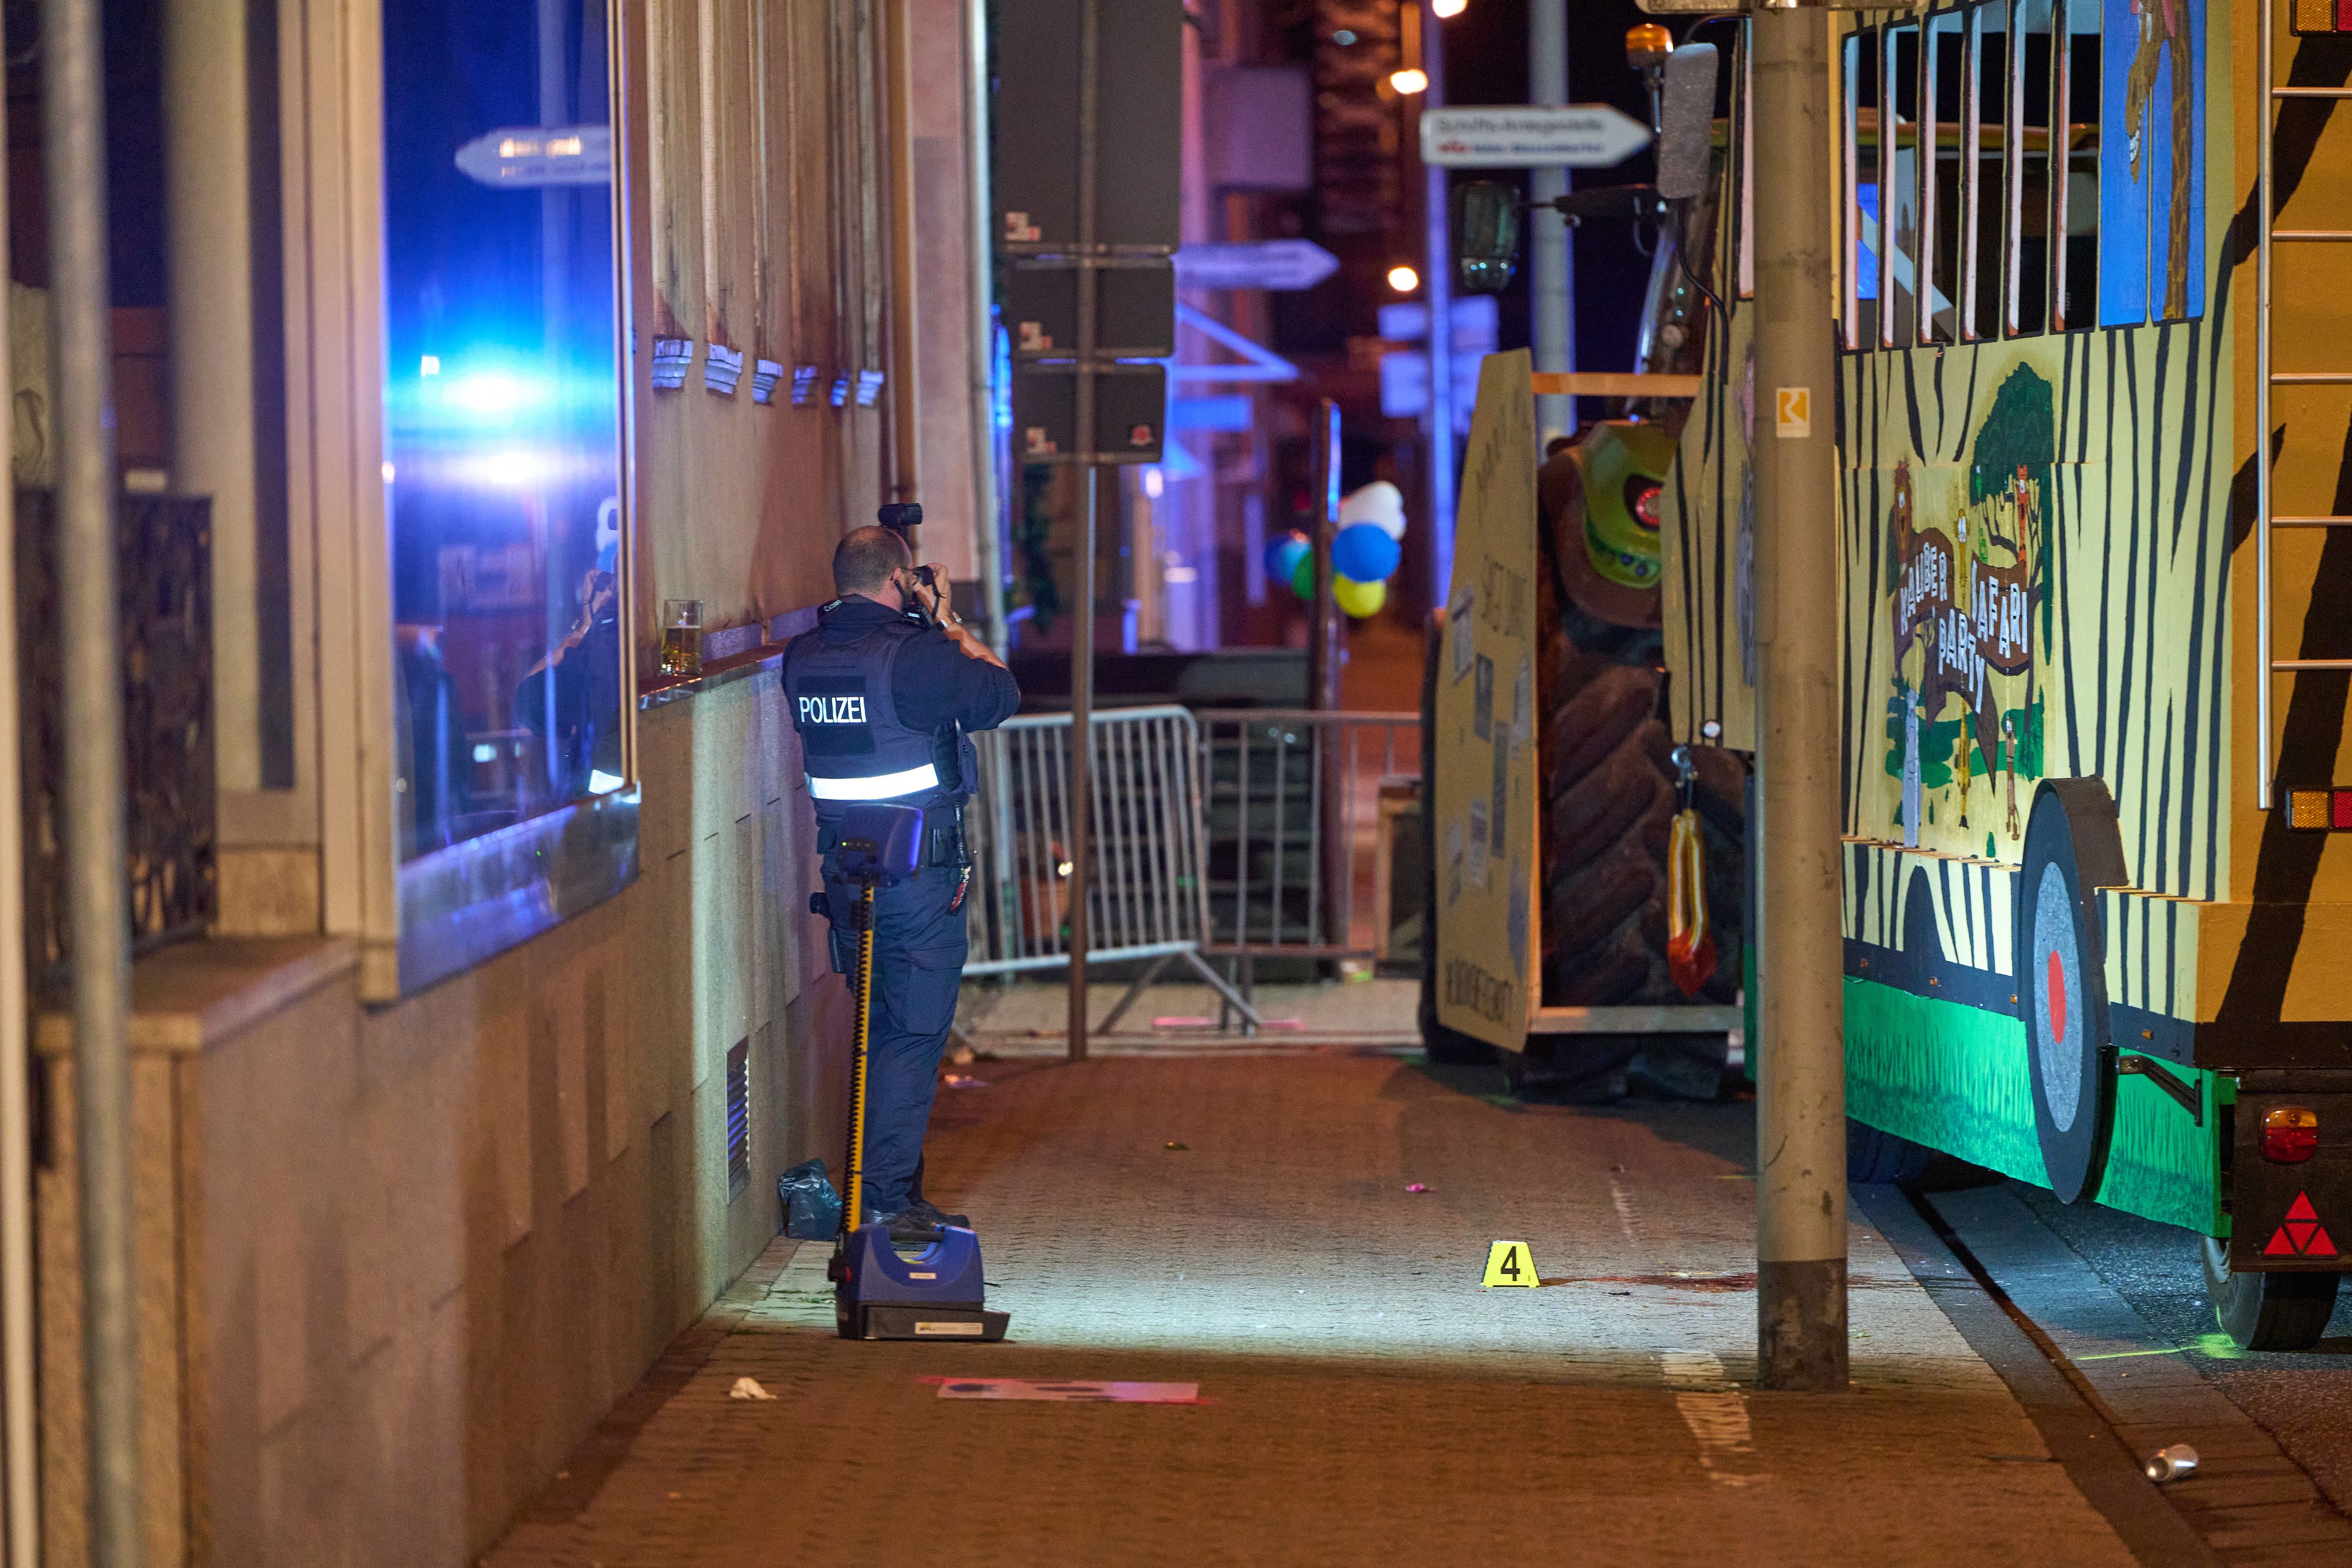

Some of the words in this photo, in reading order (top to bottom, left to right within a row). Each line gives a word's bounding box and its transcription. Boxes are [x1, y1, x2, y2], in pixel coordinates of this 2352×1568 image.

[1972, 560, 2027, 658] SAFARI
[1938, 609, 1985, 714] PARTY
[799, 697, 867, 723] POLIZEI
[1501, 1246, 1521, 1282] 4
